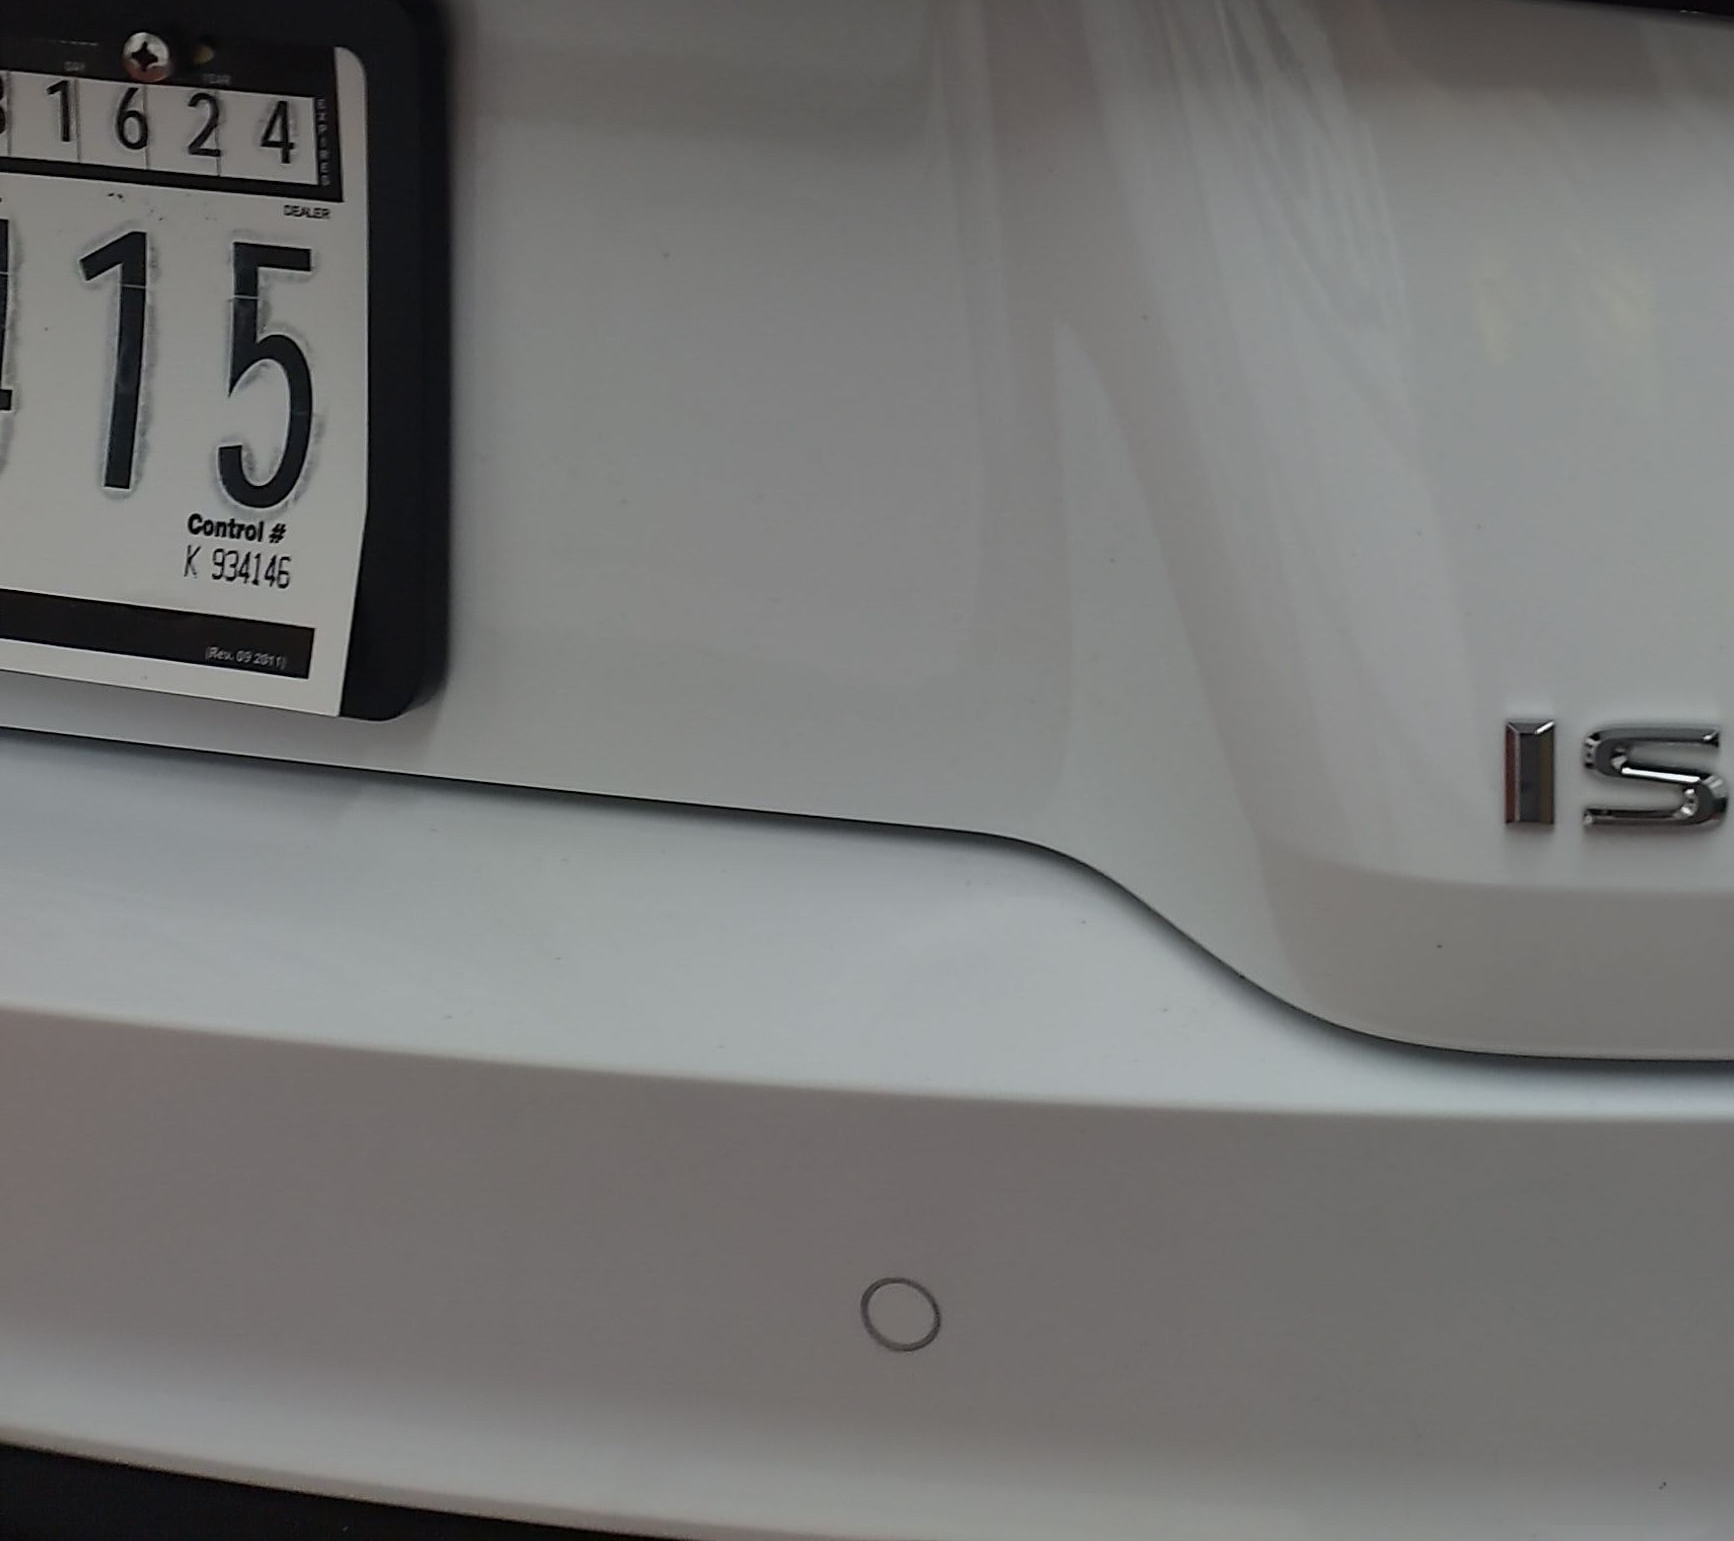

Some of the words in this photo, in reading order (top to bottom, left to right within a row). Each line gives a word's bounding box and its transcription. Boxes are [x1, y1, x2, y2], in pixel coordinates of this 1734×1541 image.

[283, 204, 331, 219] DEALER
[0, 217, 315, 509] 15
[187, 513, 264, 542] Control
[268, 523, 287, 544] #
[184, 545, 201, 579] K
[211, 548, 291, 589] 934146
[1504, 719, 1728, 826] IS
